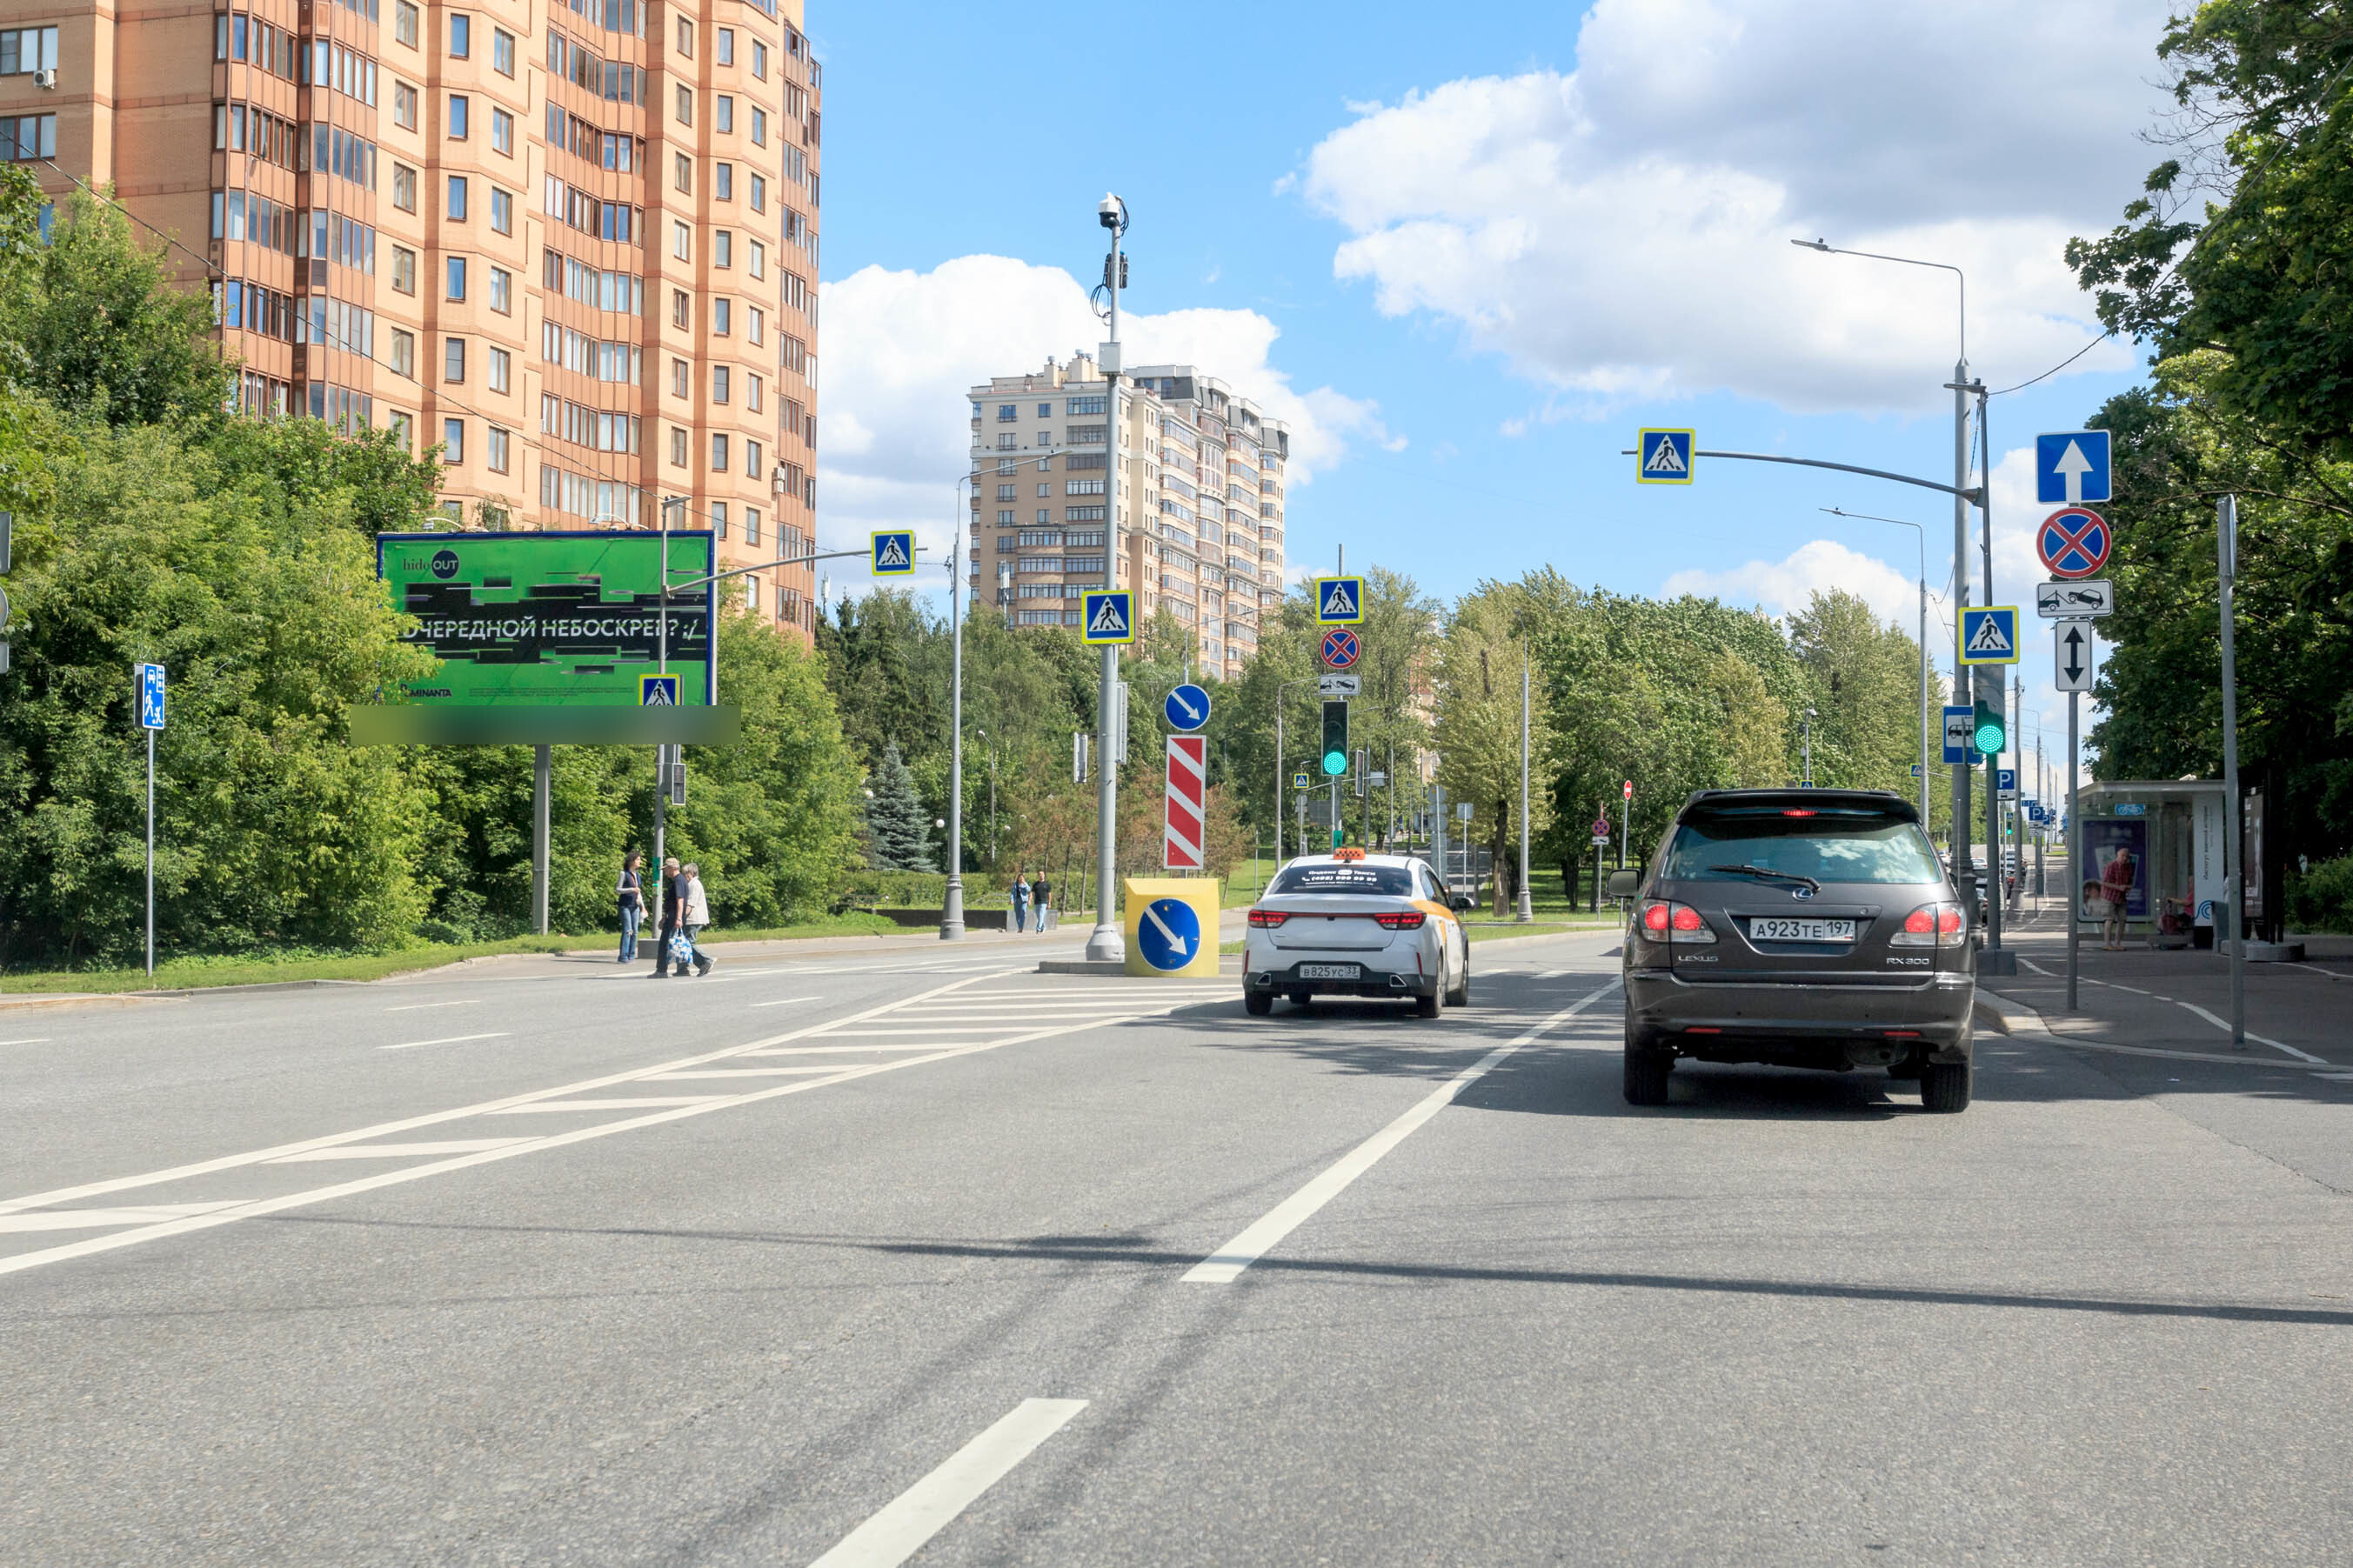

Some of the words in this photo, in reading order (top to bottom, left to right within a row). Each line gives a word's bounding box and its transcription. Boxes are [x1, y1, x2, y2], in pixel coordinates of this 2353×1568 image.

[1998, 771, 2012, 789] P
[1756, 920, 1822, 938] А923ТЕ
[1827, 921, 1851, 935] 197
[1303, 966, 1344, 977] В825УС
[1347, 966, 1357, 975] 33
